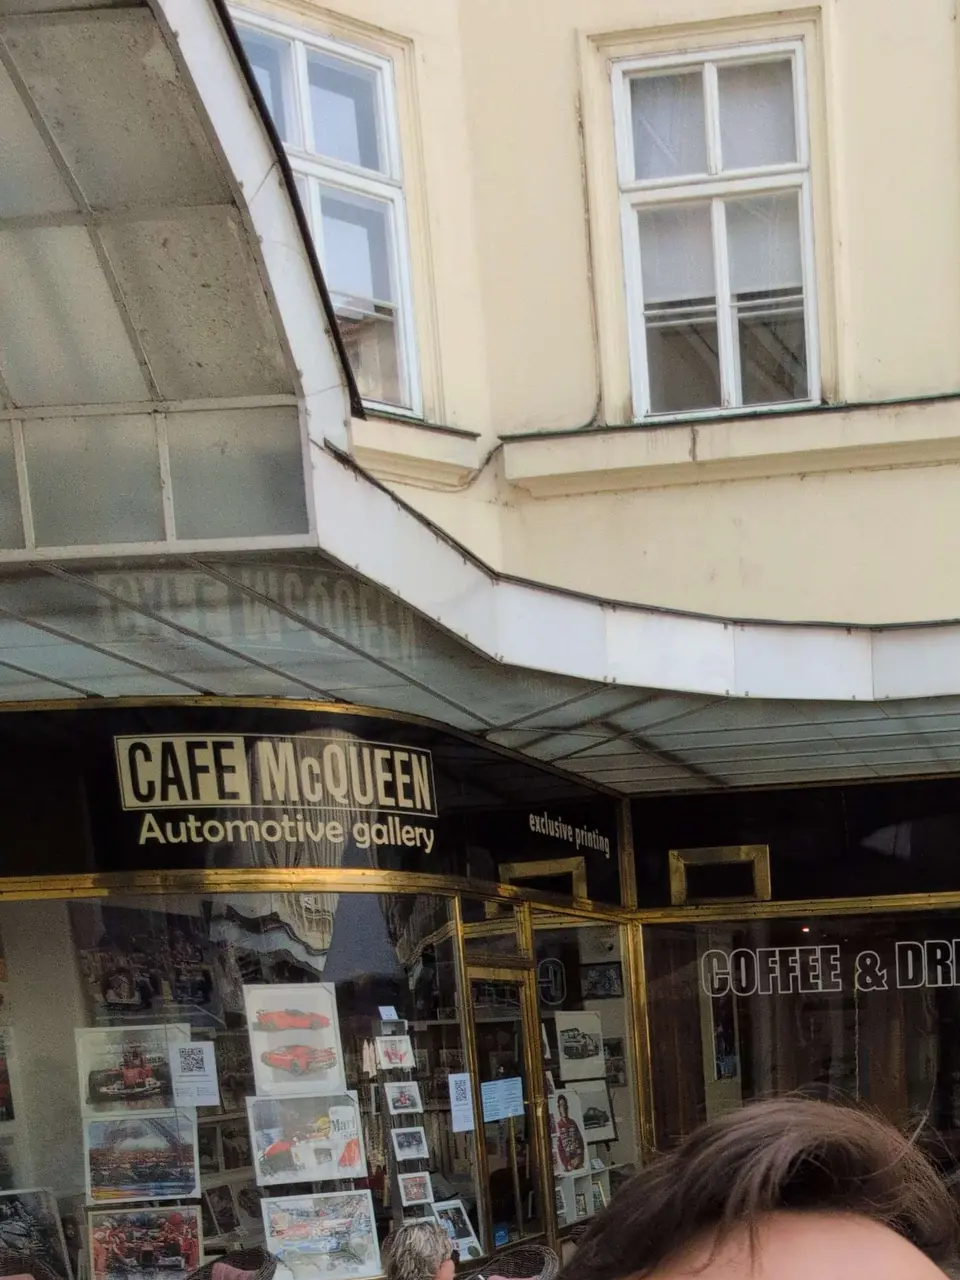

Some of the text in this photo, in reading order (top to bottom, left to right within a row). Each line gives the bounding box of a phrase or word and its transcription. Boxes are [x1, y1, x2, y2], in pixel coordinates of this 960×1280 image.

[127, 740, 432, 811] CAFE McQUEEN
[138, 812, 435, 853] Automotive gallery
[529, 811, 610, 859] exclusive printing
[701, 945, 843, 998] COFFEE
[856, 950, 888, 992] &
